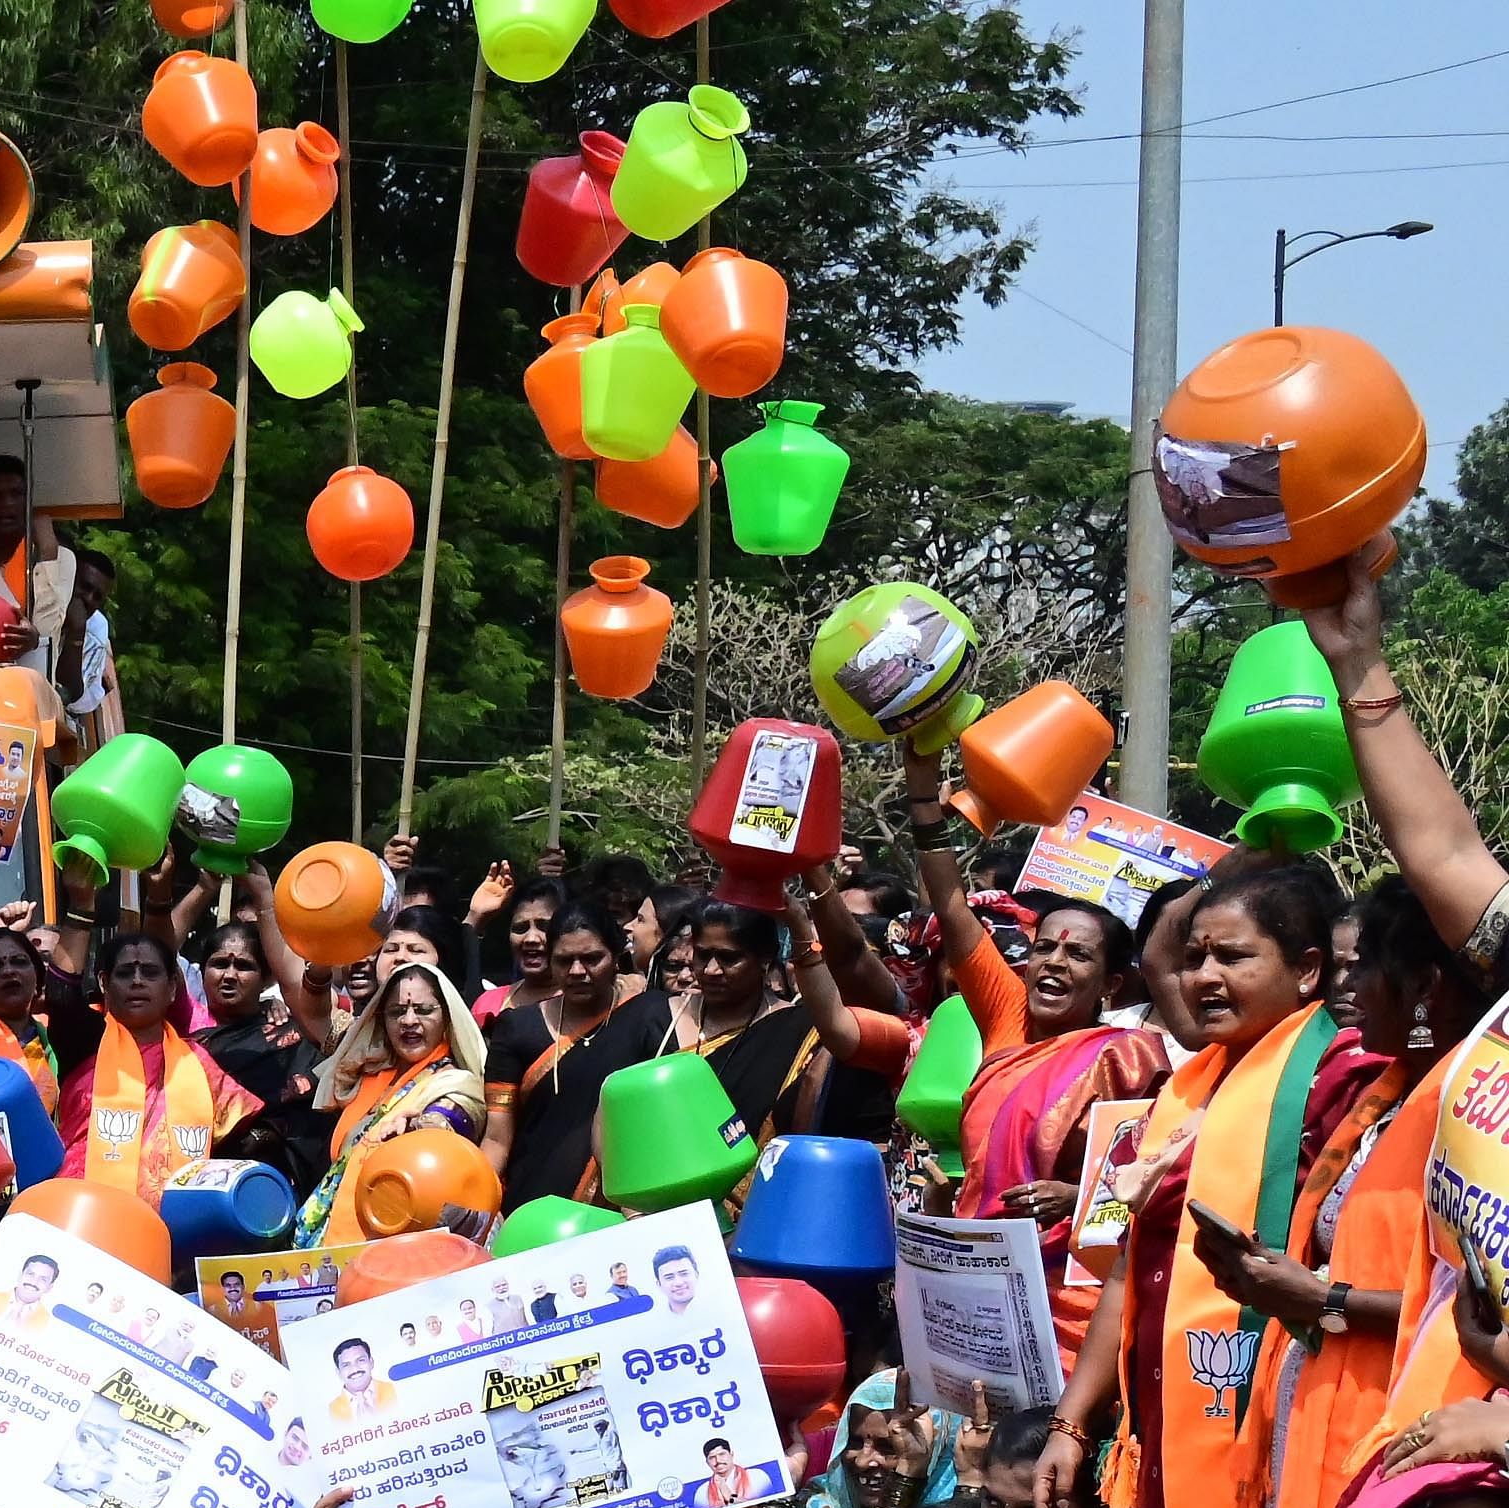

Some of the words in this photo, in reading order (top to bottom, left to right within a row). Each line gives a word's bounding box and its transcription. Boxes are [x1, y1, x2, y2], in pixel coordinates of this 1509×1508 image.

[956, 1256, 1010, 1268] ಹಾಹಾಕಾರ
[16, 1344, 55, 1368] ಮೋಸ
[56, 1363, 91, 1386] ಮಾಡಿ
[428, 1333, 515, 1366] ಗೋವಿಂದರಾಜನಗರ
[516, 1320, 571, 1342] ವಿಧಾನಸಭಾ
[572, 1313, 594, 1329] ಕ್ಷೇತ್ರ
[622, 1328, 727, 1385] ಧಿಕ್ಕಾರ
[31, 1383, 81, 1412] ಕಾವೇರಿ
[637, 1380, 742, 1438] ಧಿಕ್ಕಾರ
[321, 1425, 384, 1456] ಕನ್ನಡಿಗರಿಗೆ
[388, 1415, 431, 1436] ಮೋಸ
[435, 1401, 474, 1423] ಮಾಡಿ
[328, 1444, 427, 1486] ತಮಿಳುನಾಡಿಗೆ
[430, 1429, 486, 1457] ಕಾವೇರಿ
[377, 1458, 469, 1495] ಹರಿಸುತ್ತಿರುವ
